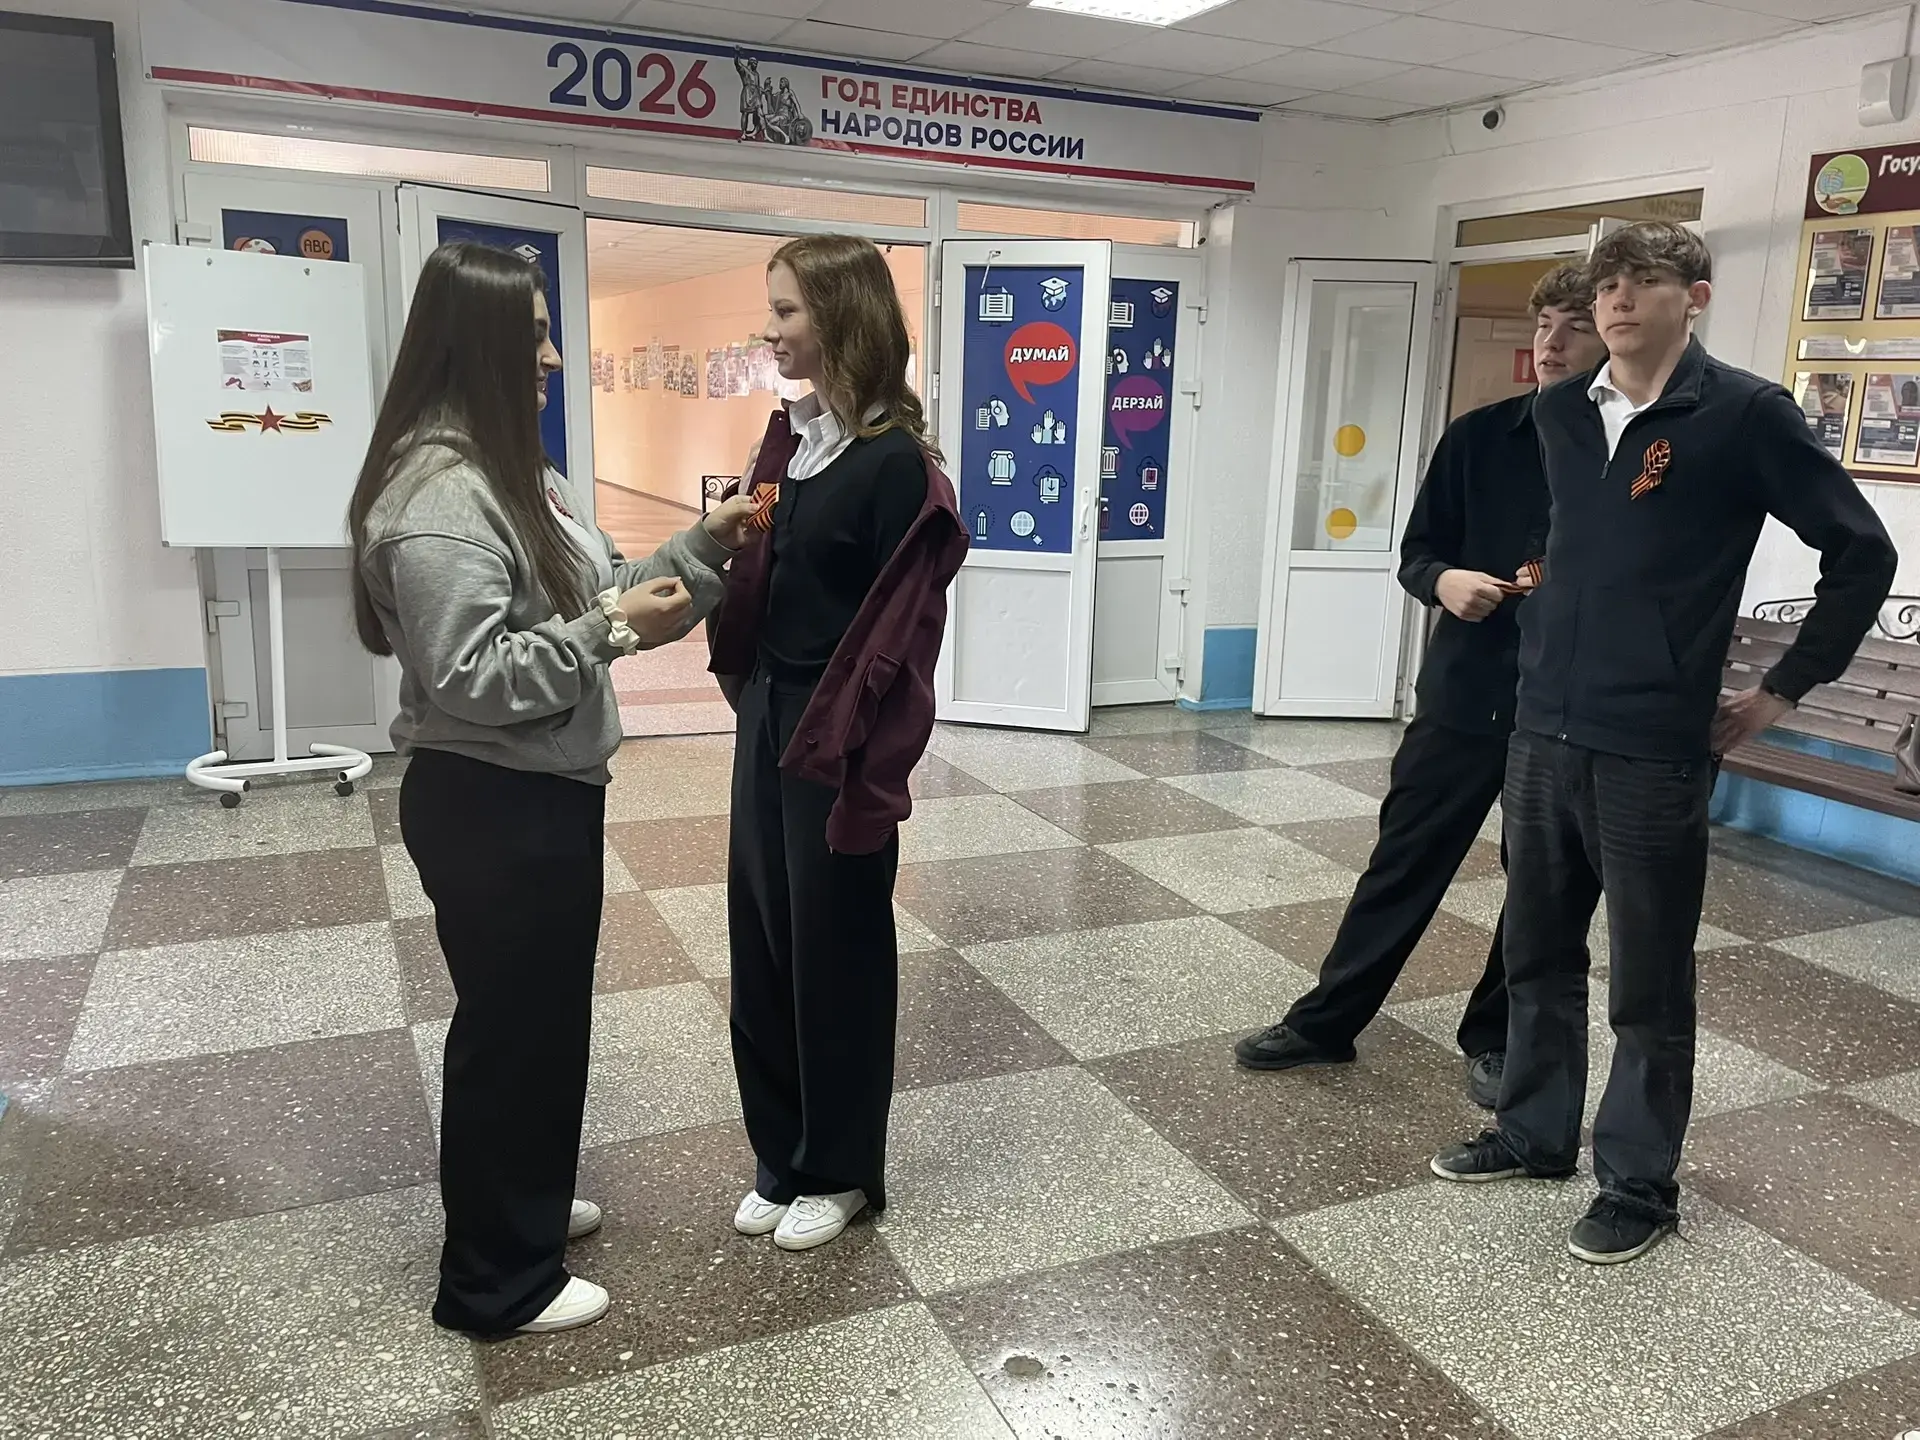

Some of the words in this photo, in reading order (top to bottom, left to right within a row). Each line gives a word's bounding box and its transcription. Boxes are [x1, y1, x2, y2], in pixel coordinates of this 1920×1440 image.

[547, 42, 716, 119] 2026
[821, 75, 881, 110] ГОД
[892, 84, 1042, 125] ЕДИНСТВА
[821, 109, 962, 147] НАРОДОВ
[971, 126, 1084, 160] РОССИИ
[303, 239, 331, 254] ABC
[1010, 345, 1070, 363] ДУМАЙ
[1111, 395, 1164, 411] ДЕРЗАЙ
